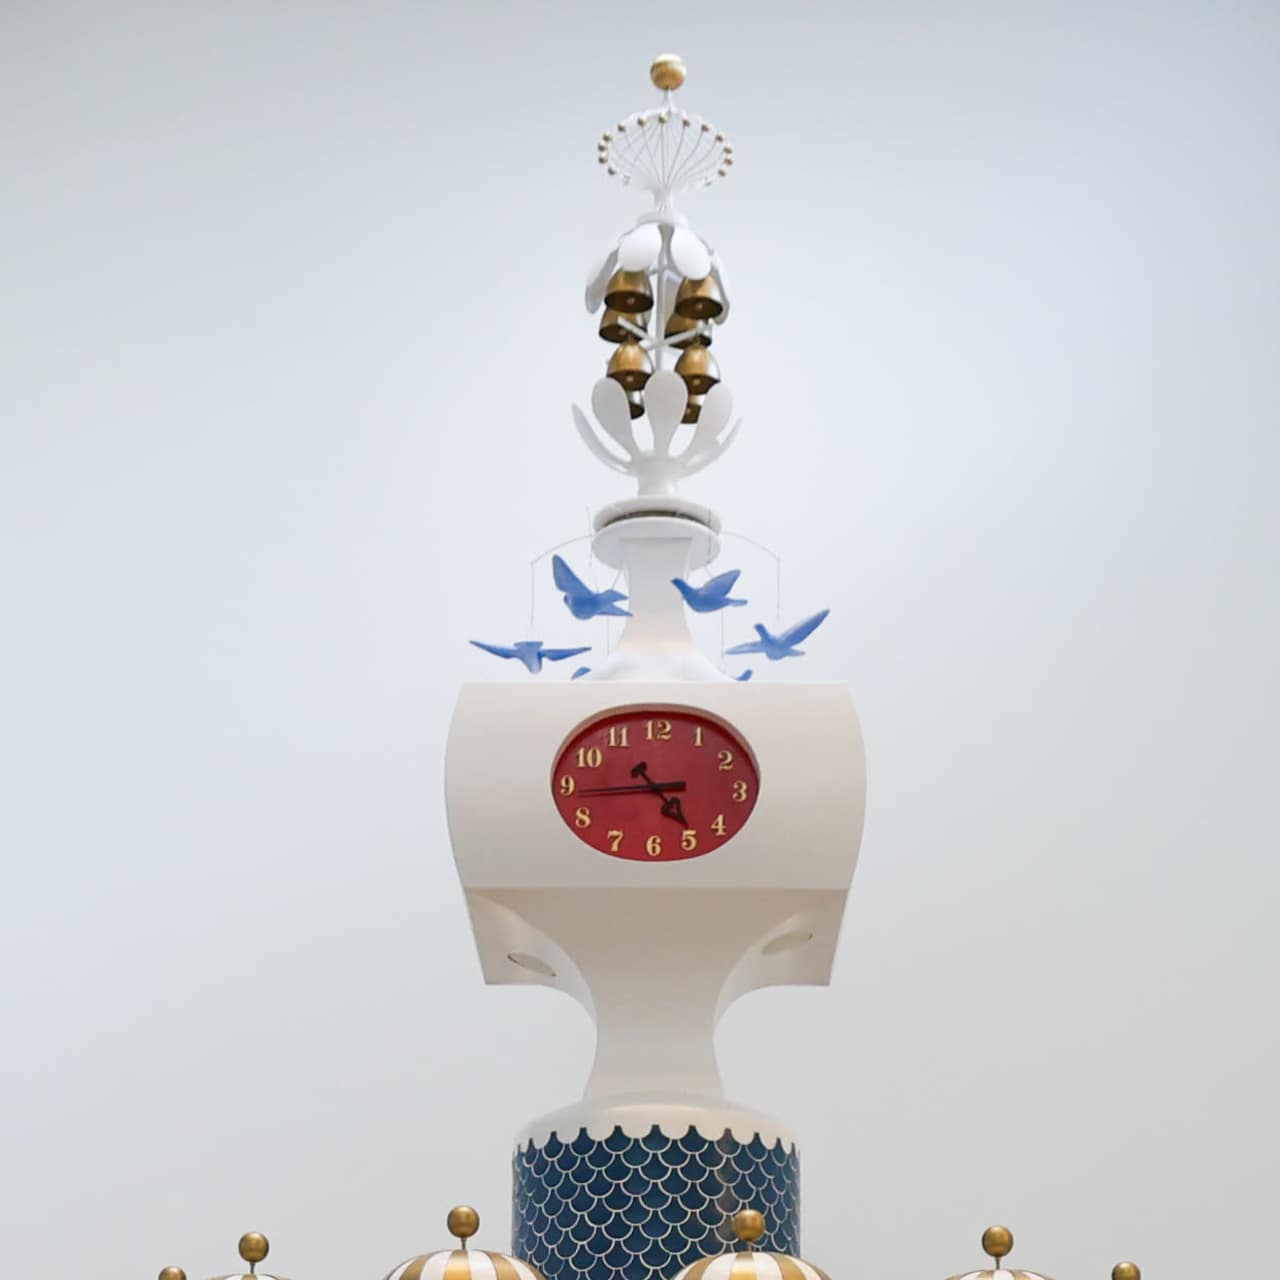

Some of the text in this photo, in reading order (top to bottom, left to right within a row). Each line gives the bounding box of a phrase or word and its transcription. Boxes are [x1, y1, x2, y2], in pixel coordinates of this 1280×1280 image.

[607, 727, 629, 748] 11
[645, 720, 672, 740] 12
[694, 727, 704, 747] 1
[576, 747, 602, 768] 10
[718, 751, 734, 770] 2
[560, 775, 575, 796] 9
[732, 781, 748, 802] 3
[575, 807, 591, 828] 8
[711, 814, 727, 836] 4
[607, 830, 623, 851] 7
[646, 835, 662, 856] 6
[681, 830, 697, 850] 5
